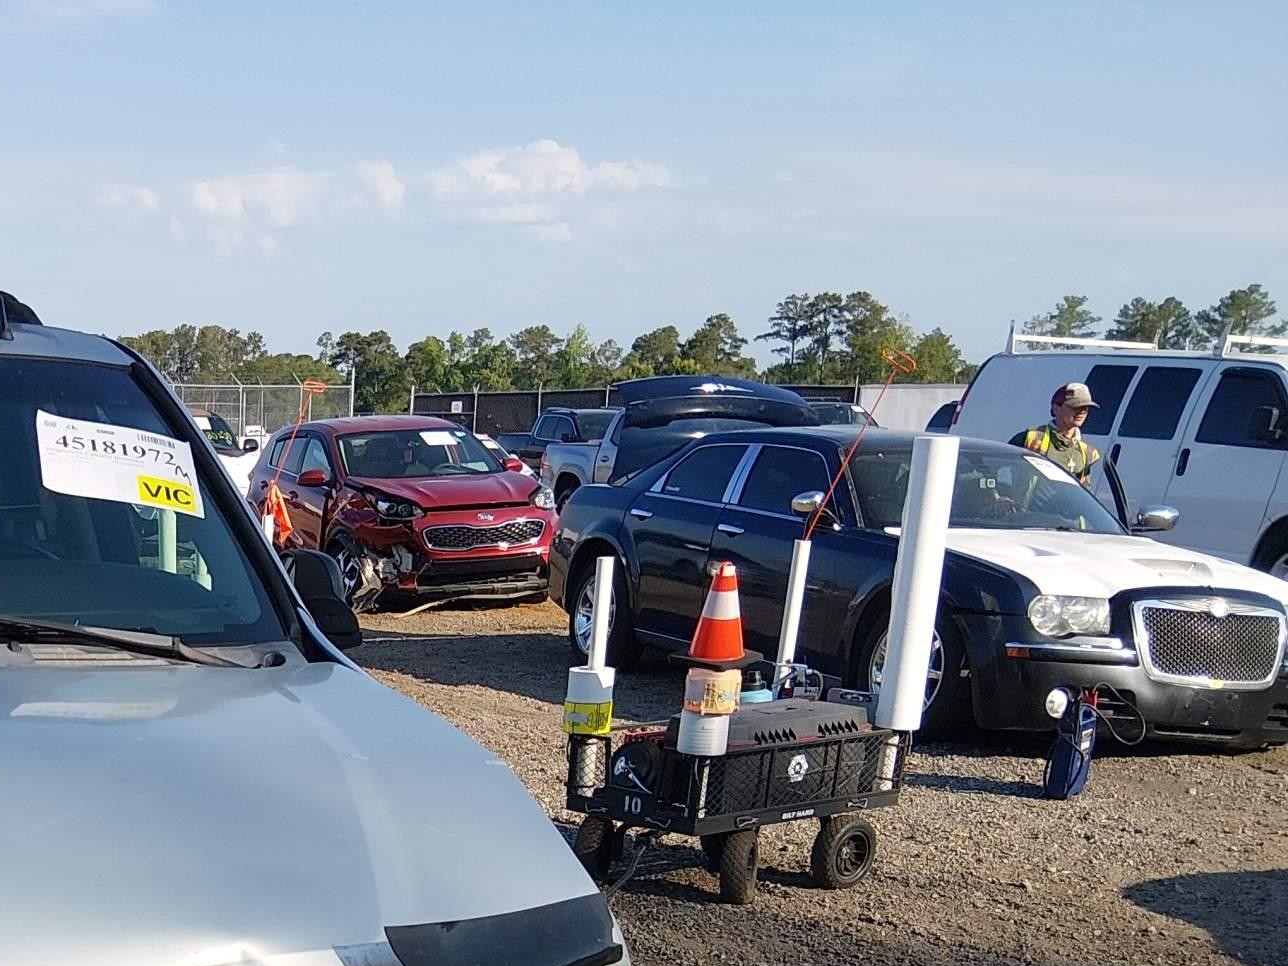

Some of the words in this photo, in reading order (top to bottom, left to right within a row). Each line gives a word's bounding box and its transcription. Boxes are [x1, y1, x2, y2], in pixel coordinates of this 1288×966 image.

[56, 435, 177, 466] 45181972
[142, 481, 192, 505] VIC
[624, 795, 642, 815] 10
